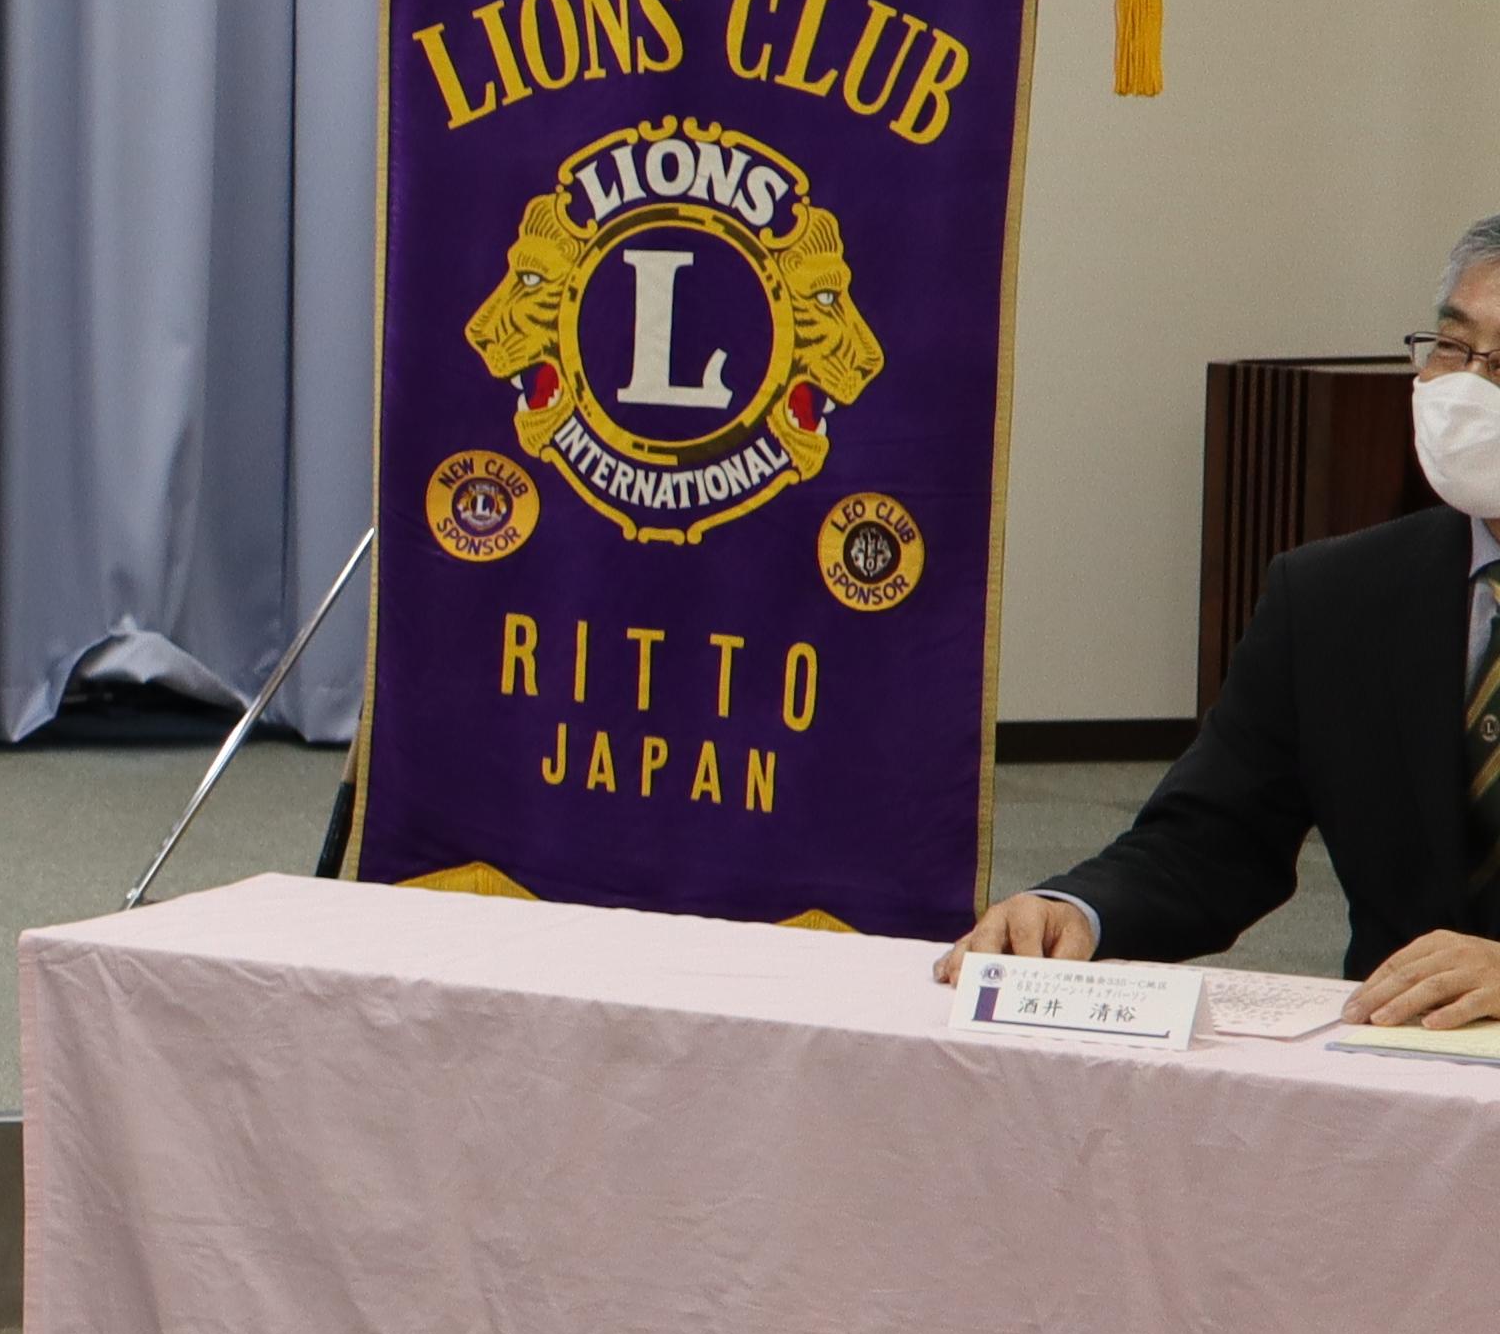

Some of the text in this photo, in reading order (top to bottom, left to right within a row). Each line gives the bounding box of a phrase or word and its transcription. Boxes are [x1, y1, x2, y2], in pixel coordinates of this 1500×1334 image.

[575, 139, 789, 227] LIONS
[617, 249, 733, 409] L
[438, 457, 528, 498] NEW CLUB
[555, 416, 789, 509] INTERNATIONAL
[476, 494, 491, 516] L
[831, 499, 916, 545] LEO CLUB
[437, 517, 521, 556] SPONSOR
[827, 562, 909, 605] SPONSOR
[501, 612, 819, 732] RITTO
[542, 723, 776, 814] JAPAN
[1018, 997, 1062, 1017] 酒井
